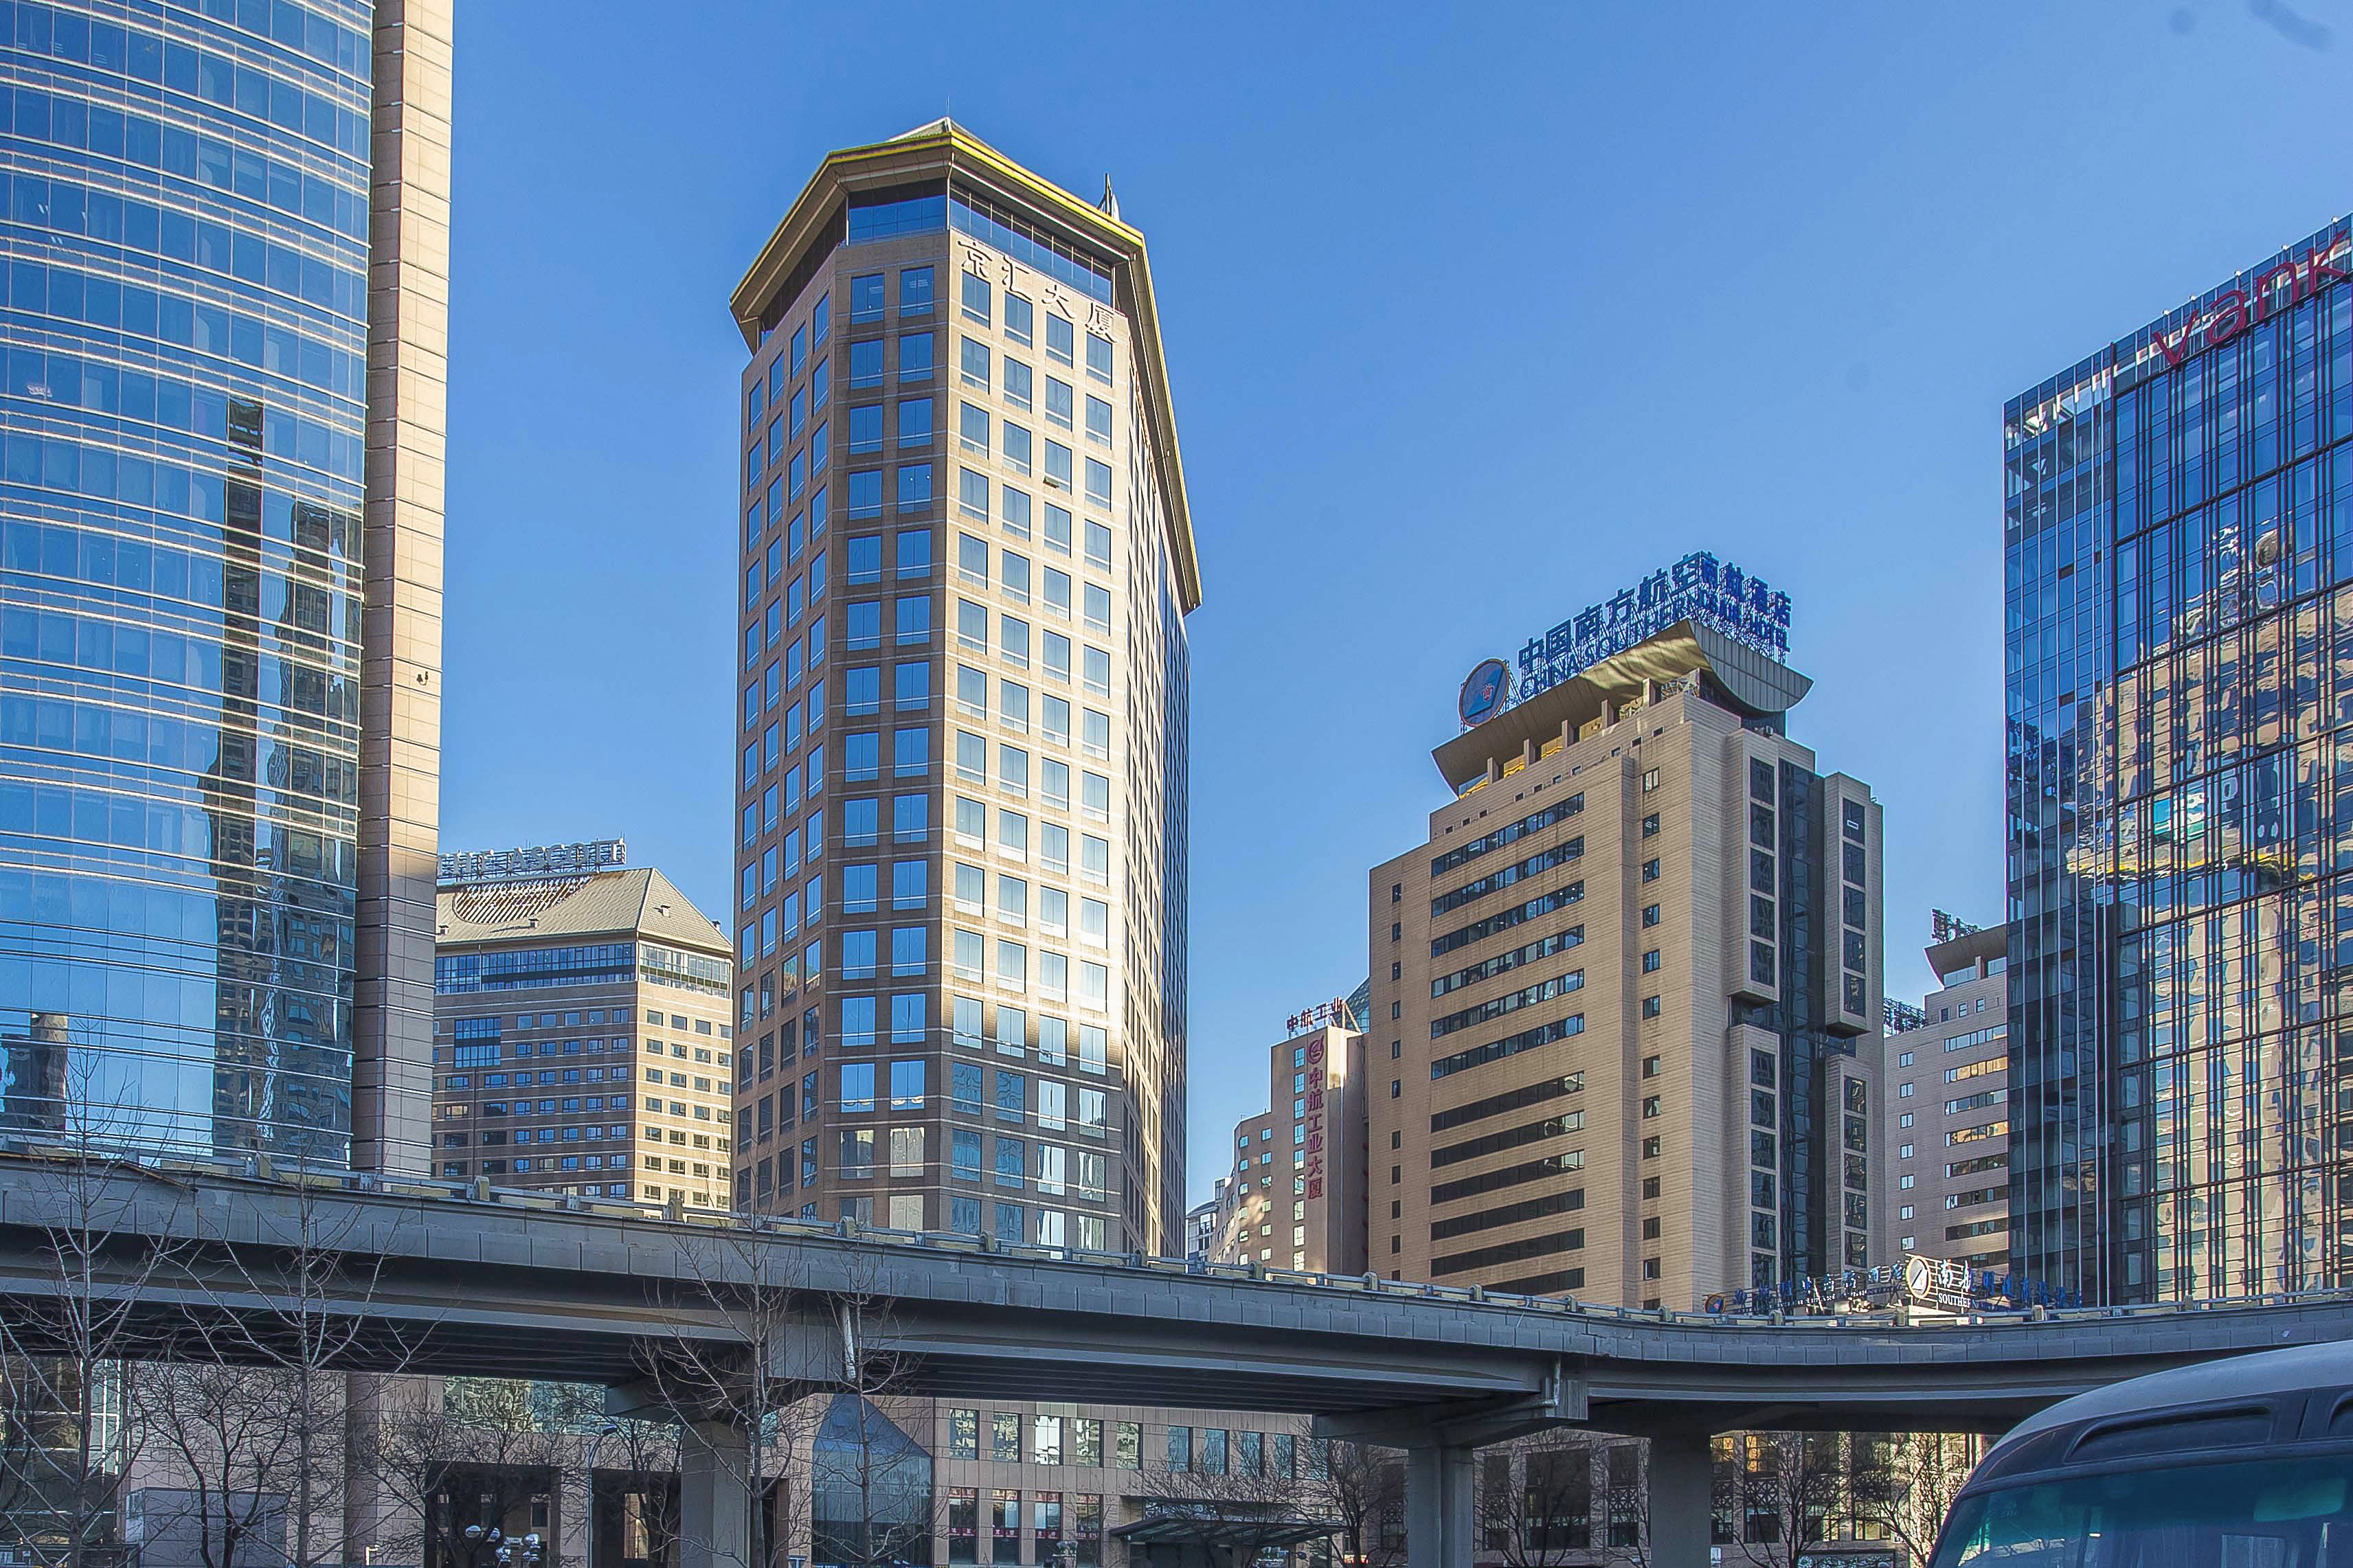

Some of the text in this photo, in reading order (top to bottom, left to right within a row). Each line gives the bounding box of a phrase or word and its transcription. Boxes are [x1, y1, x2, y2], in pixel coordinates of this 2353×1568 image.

[1518, 552, 1700, 670] 中国南方航空
[1520, 589, 1704, 699] CHINA SOUTHERN
[506, 840, 625, 872] ASCOTT
[1287, 997, 1343, 1032] 中航工业
[1307, 1067, 1324, 1200] 中航工业大厦
